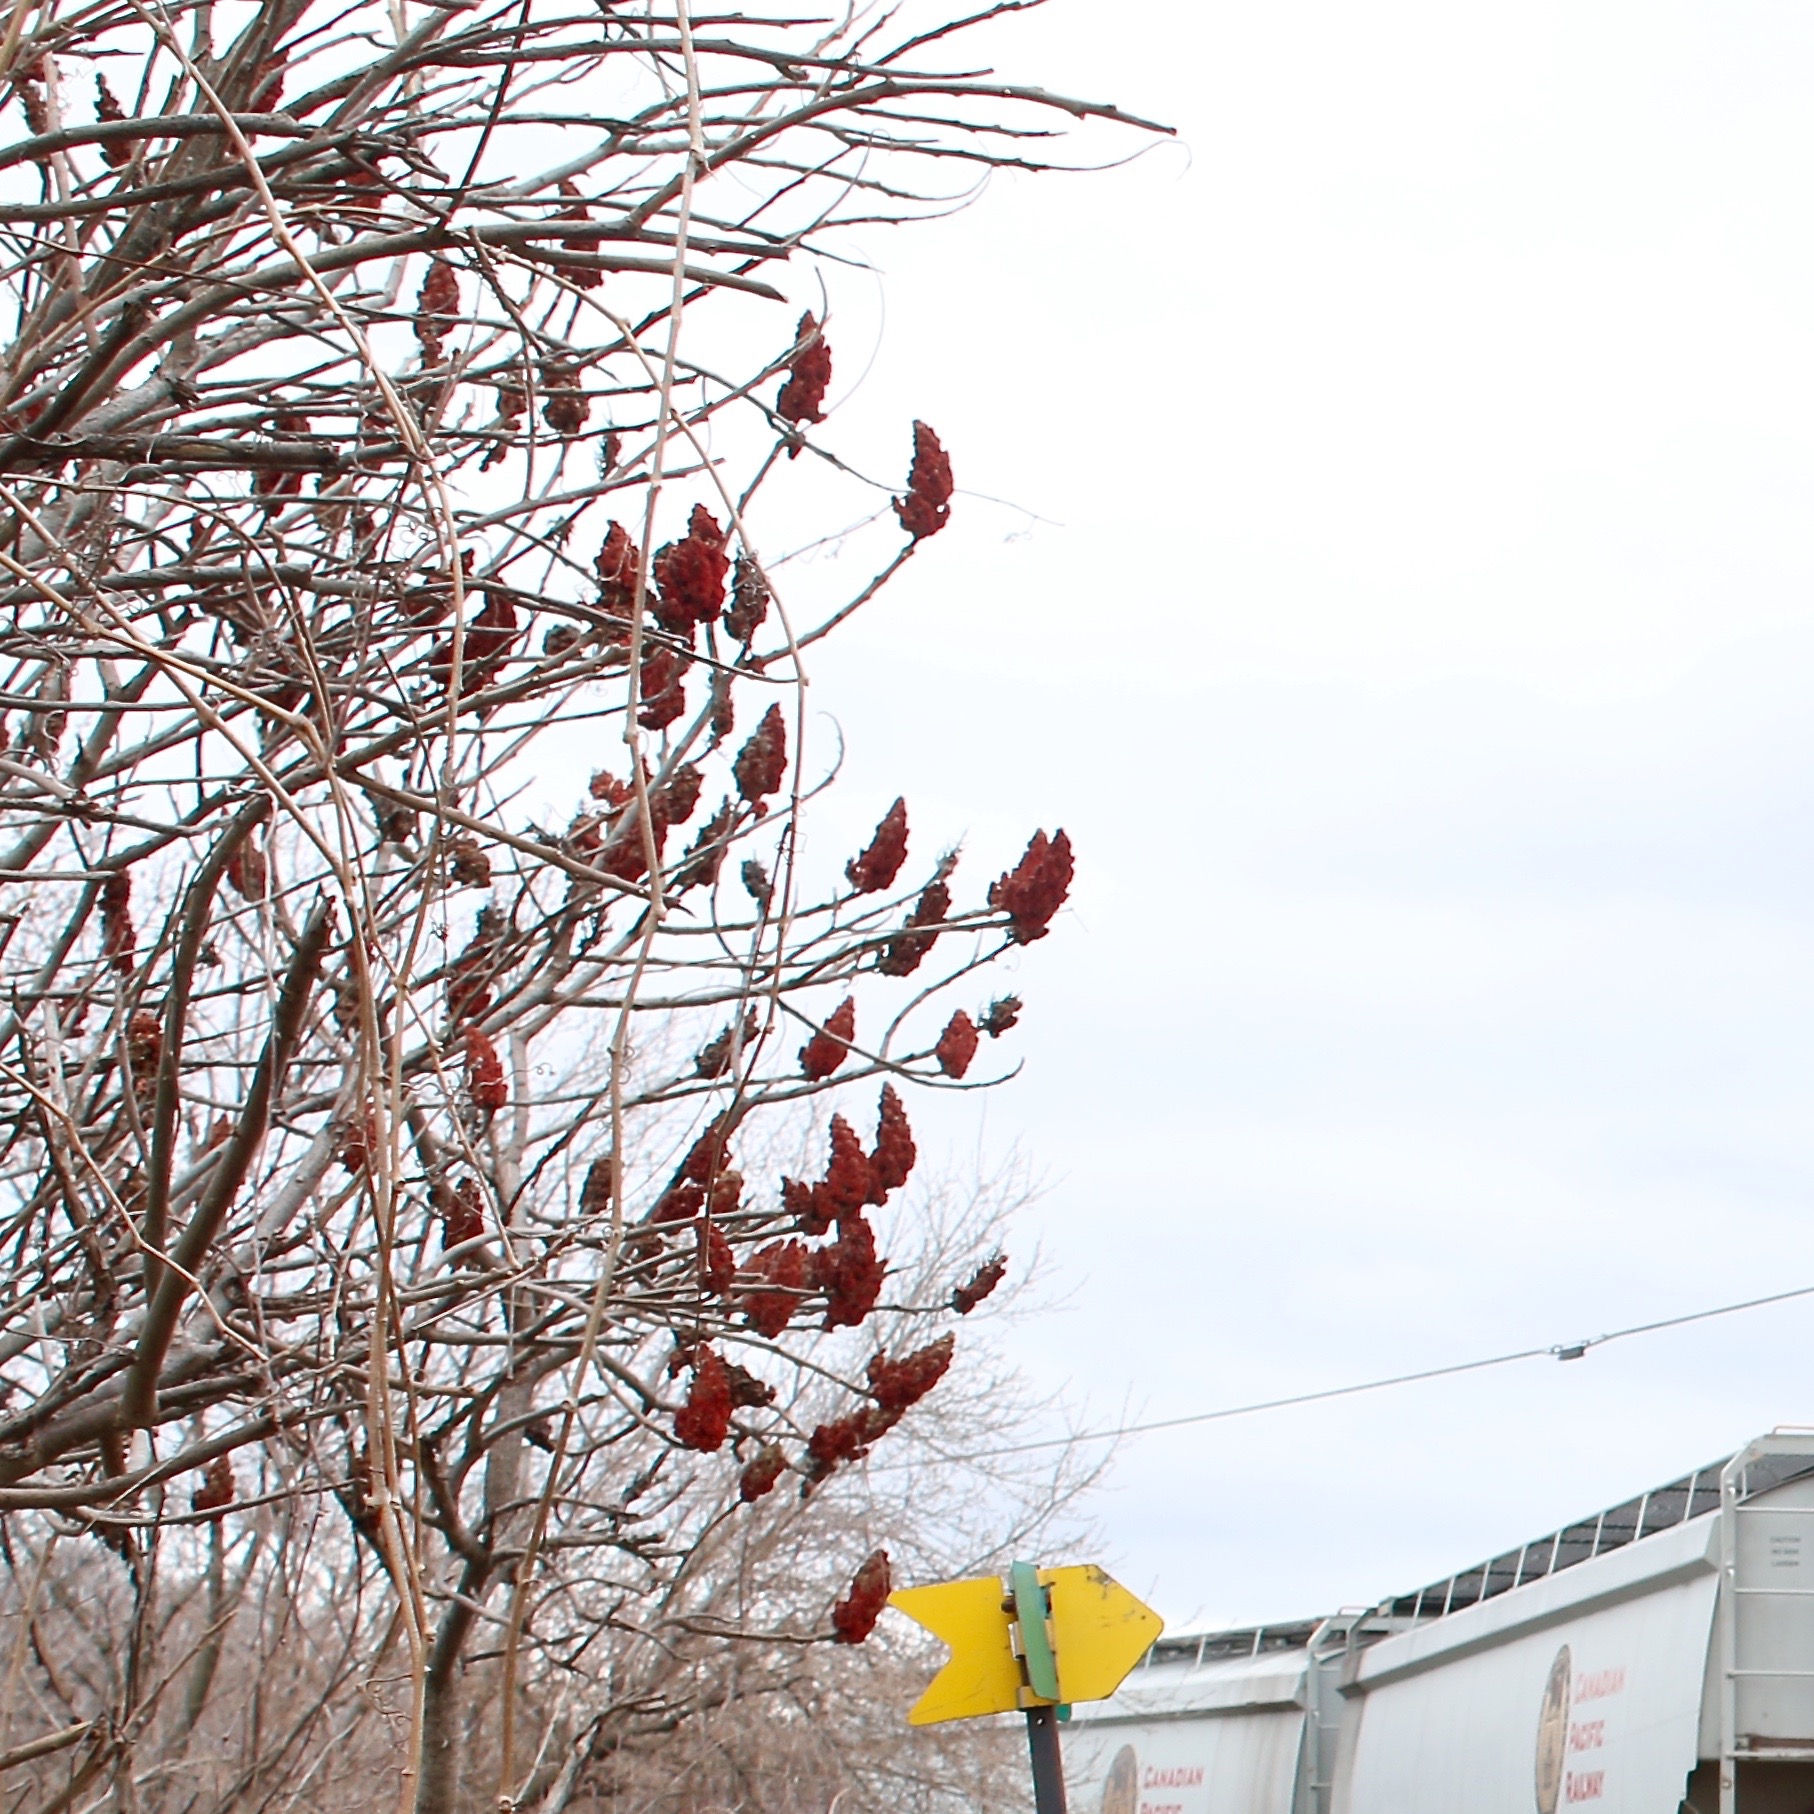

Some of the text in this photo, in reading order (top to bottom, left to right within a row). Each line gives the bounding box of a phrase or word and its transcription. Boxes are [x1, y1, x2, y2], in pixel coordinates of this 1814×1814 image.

[1573, 1666, 1627, 1704] CANADIAN
[1569, 1719, 1604, 1751] PACIFIC
[1144, 1766, 1204, 1790] CANADIAN
[1565, 1770, 1604, 1803] RAILWAY
